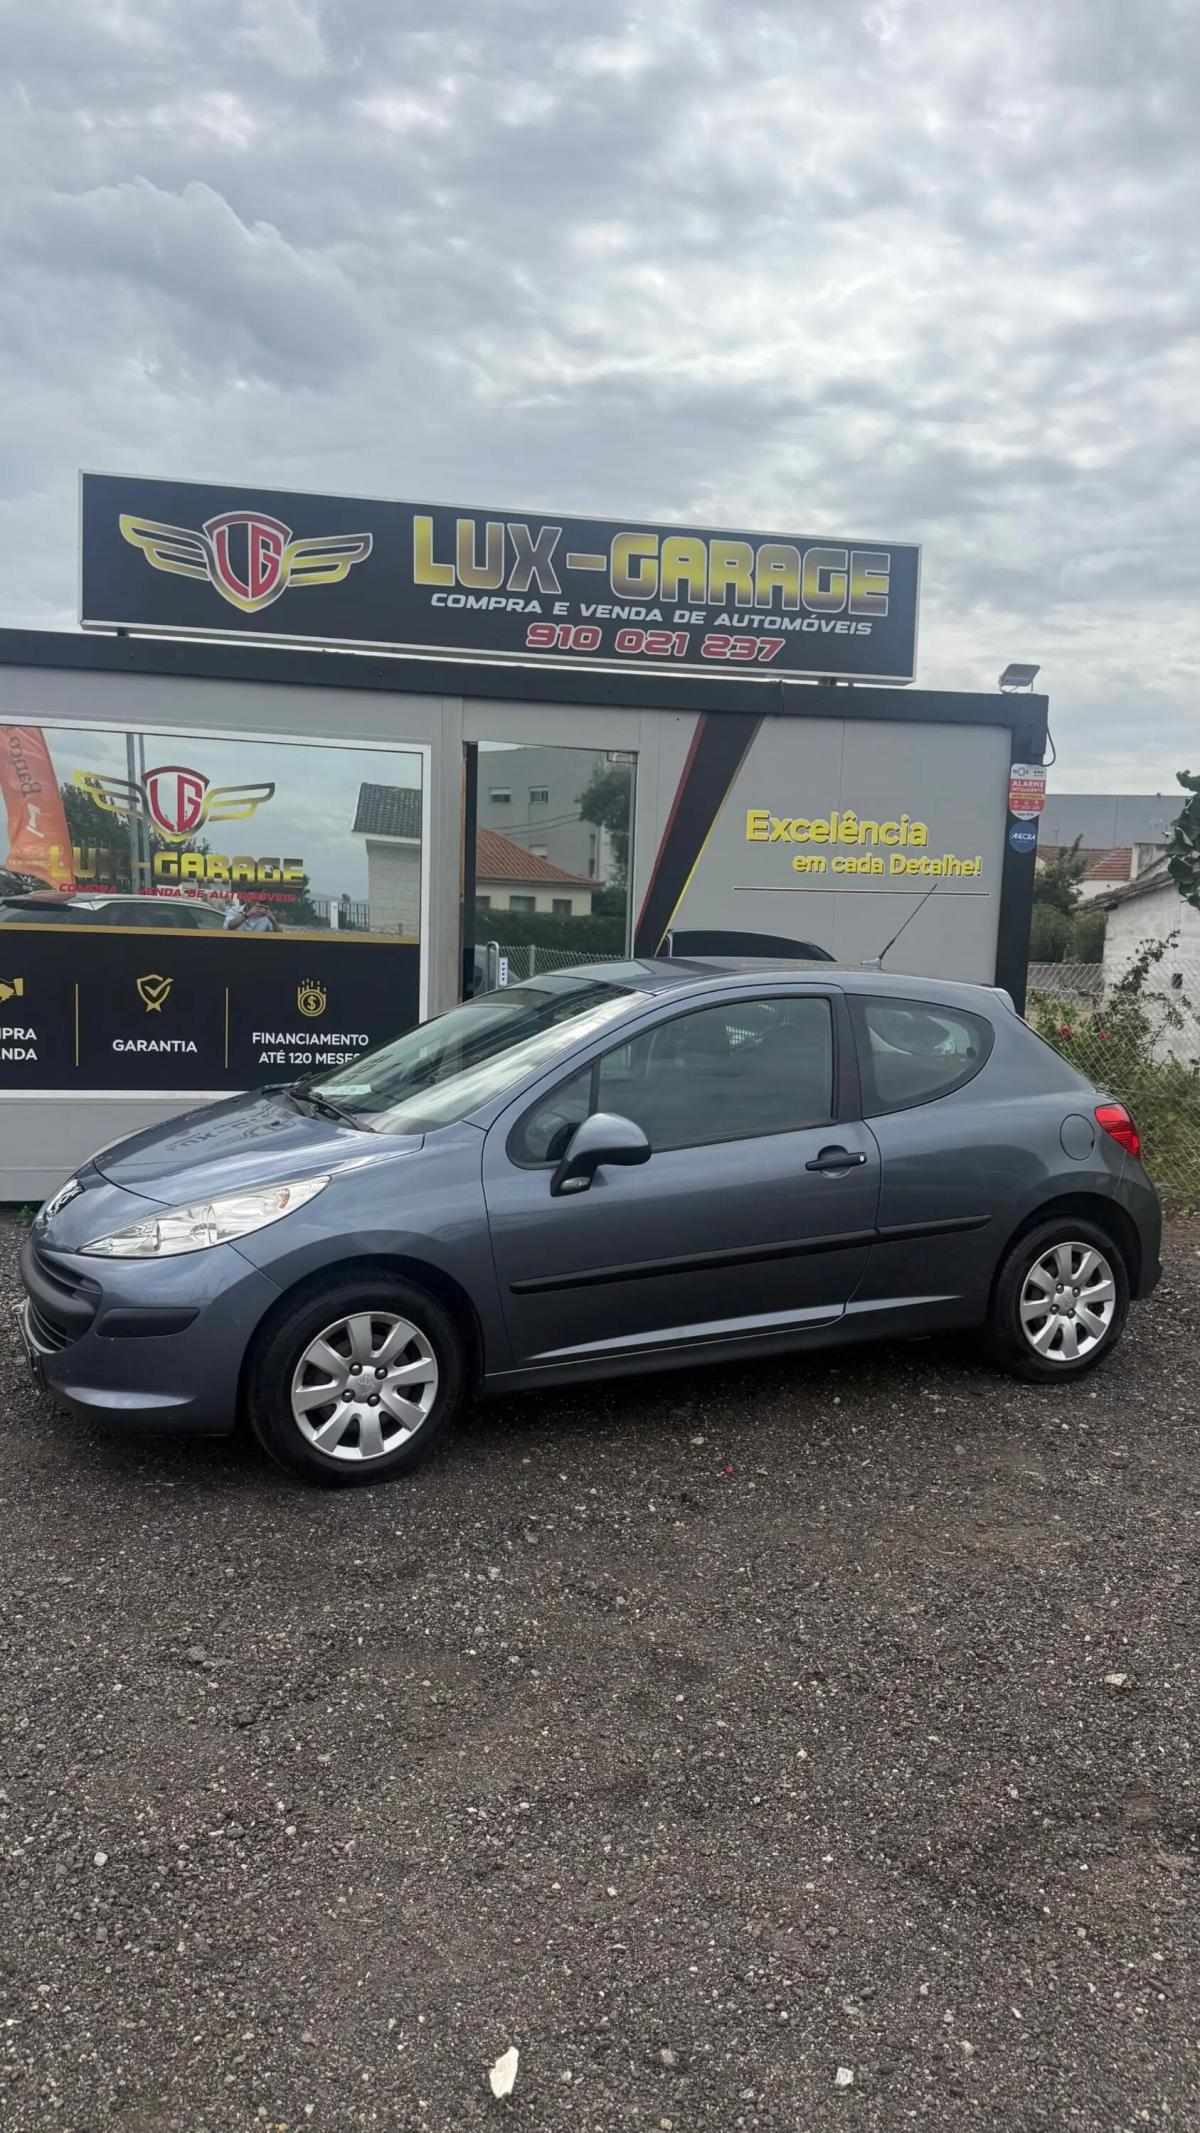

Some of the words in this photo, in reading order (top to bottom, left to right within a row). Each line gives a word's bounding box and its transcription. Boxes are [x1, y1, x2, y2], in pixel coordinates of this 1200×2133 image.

[413, 515, 891, 617] LUX-GARAGE
[431, 593, 542, 613] COMPRA
[553, 602, 570, 616] E
[580, 603, 663, 622] VENDA
[673, 609, 707, 625] DE
[714, 612, 873, 635] AUTOMÓVEIS
[526, 622, 602, 650] 910
[615, 628, 690, 656] 021
[701, 634, 785, 662] 237
[746, 809, 929, 847] Excelência
[792, 855, 827, 874] em
[831, 852, 884, 876] cada
[890, 853, 983, 877] Detalhe!
[112, 1039, 198, 1053] GARANTIA
[252, 1032, 369, 1046] FINANCIAMENTO
[0, 1048, 38, 1061] NDA
[259, 1050, 286, 1064] ATÉ
[289, 1052, 312, 1064] 120
